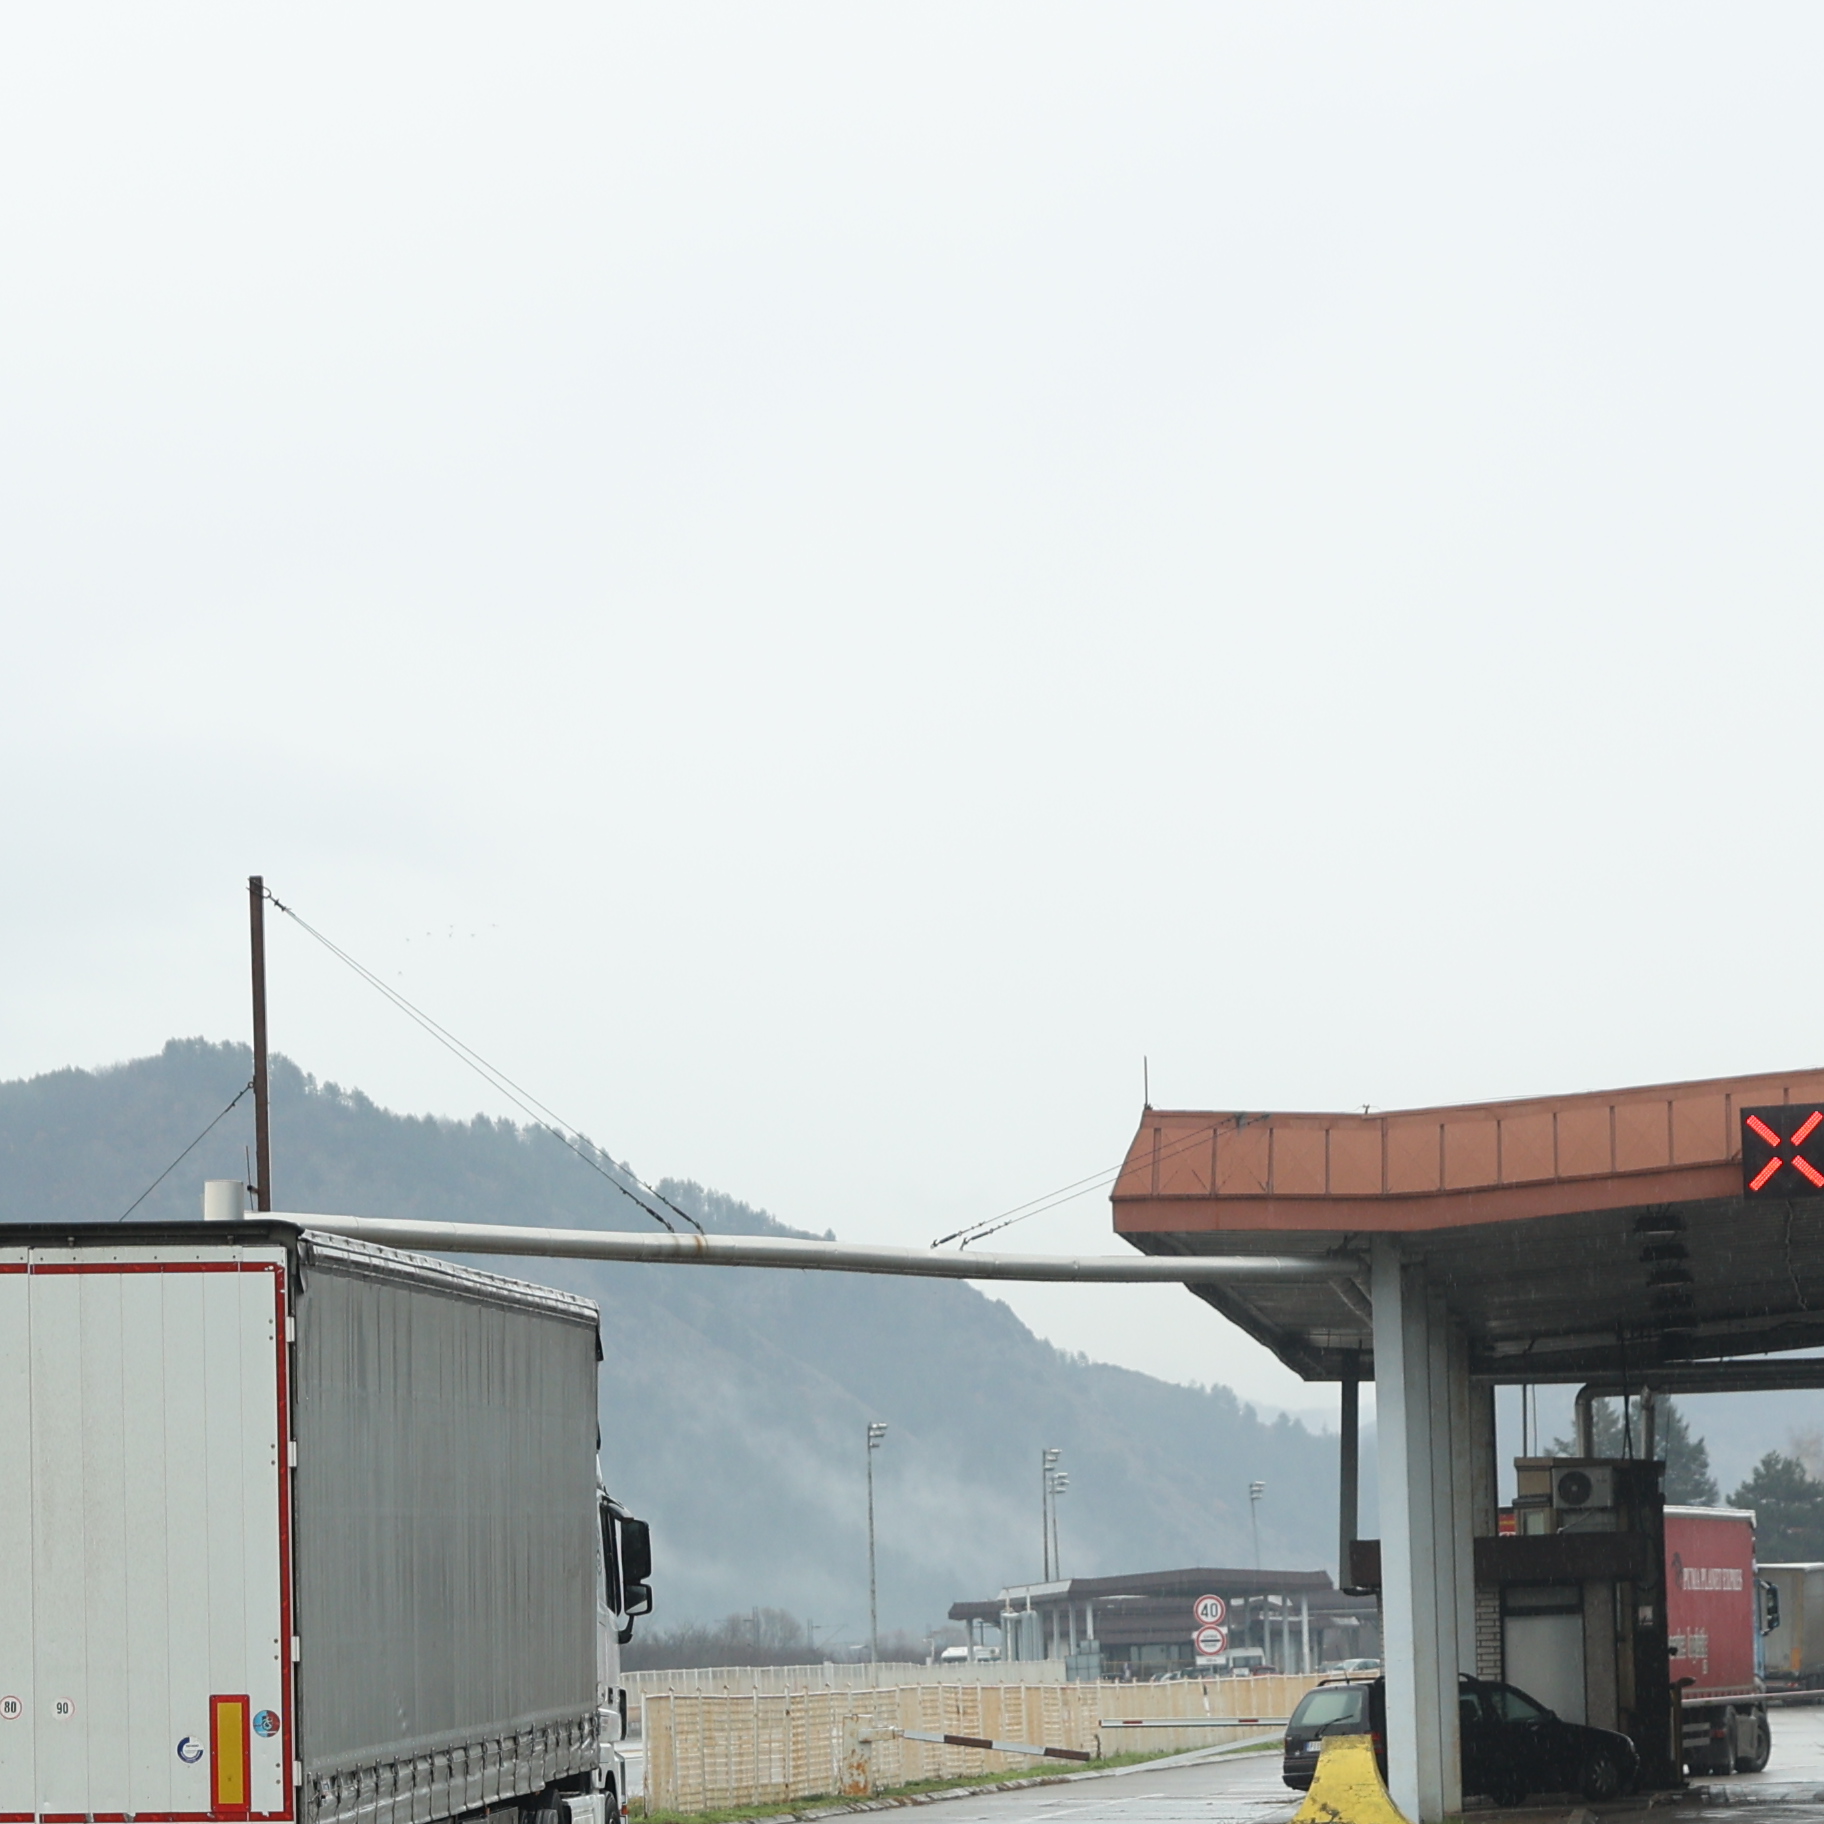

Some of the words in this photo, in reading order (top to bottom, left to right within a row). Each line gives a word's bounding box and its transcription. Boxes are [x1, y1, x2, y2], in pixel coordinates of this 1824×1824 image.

[1201, 1602, 1219, 1618] 40
[4, 1701, 17, 1714] 80
[56, 1702, 69, 1714] 90
